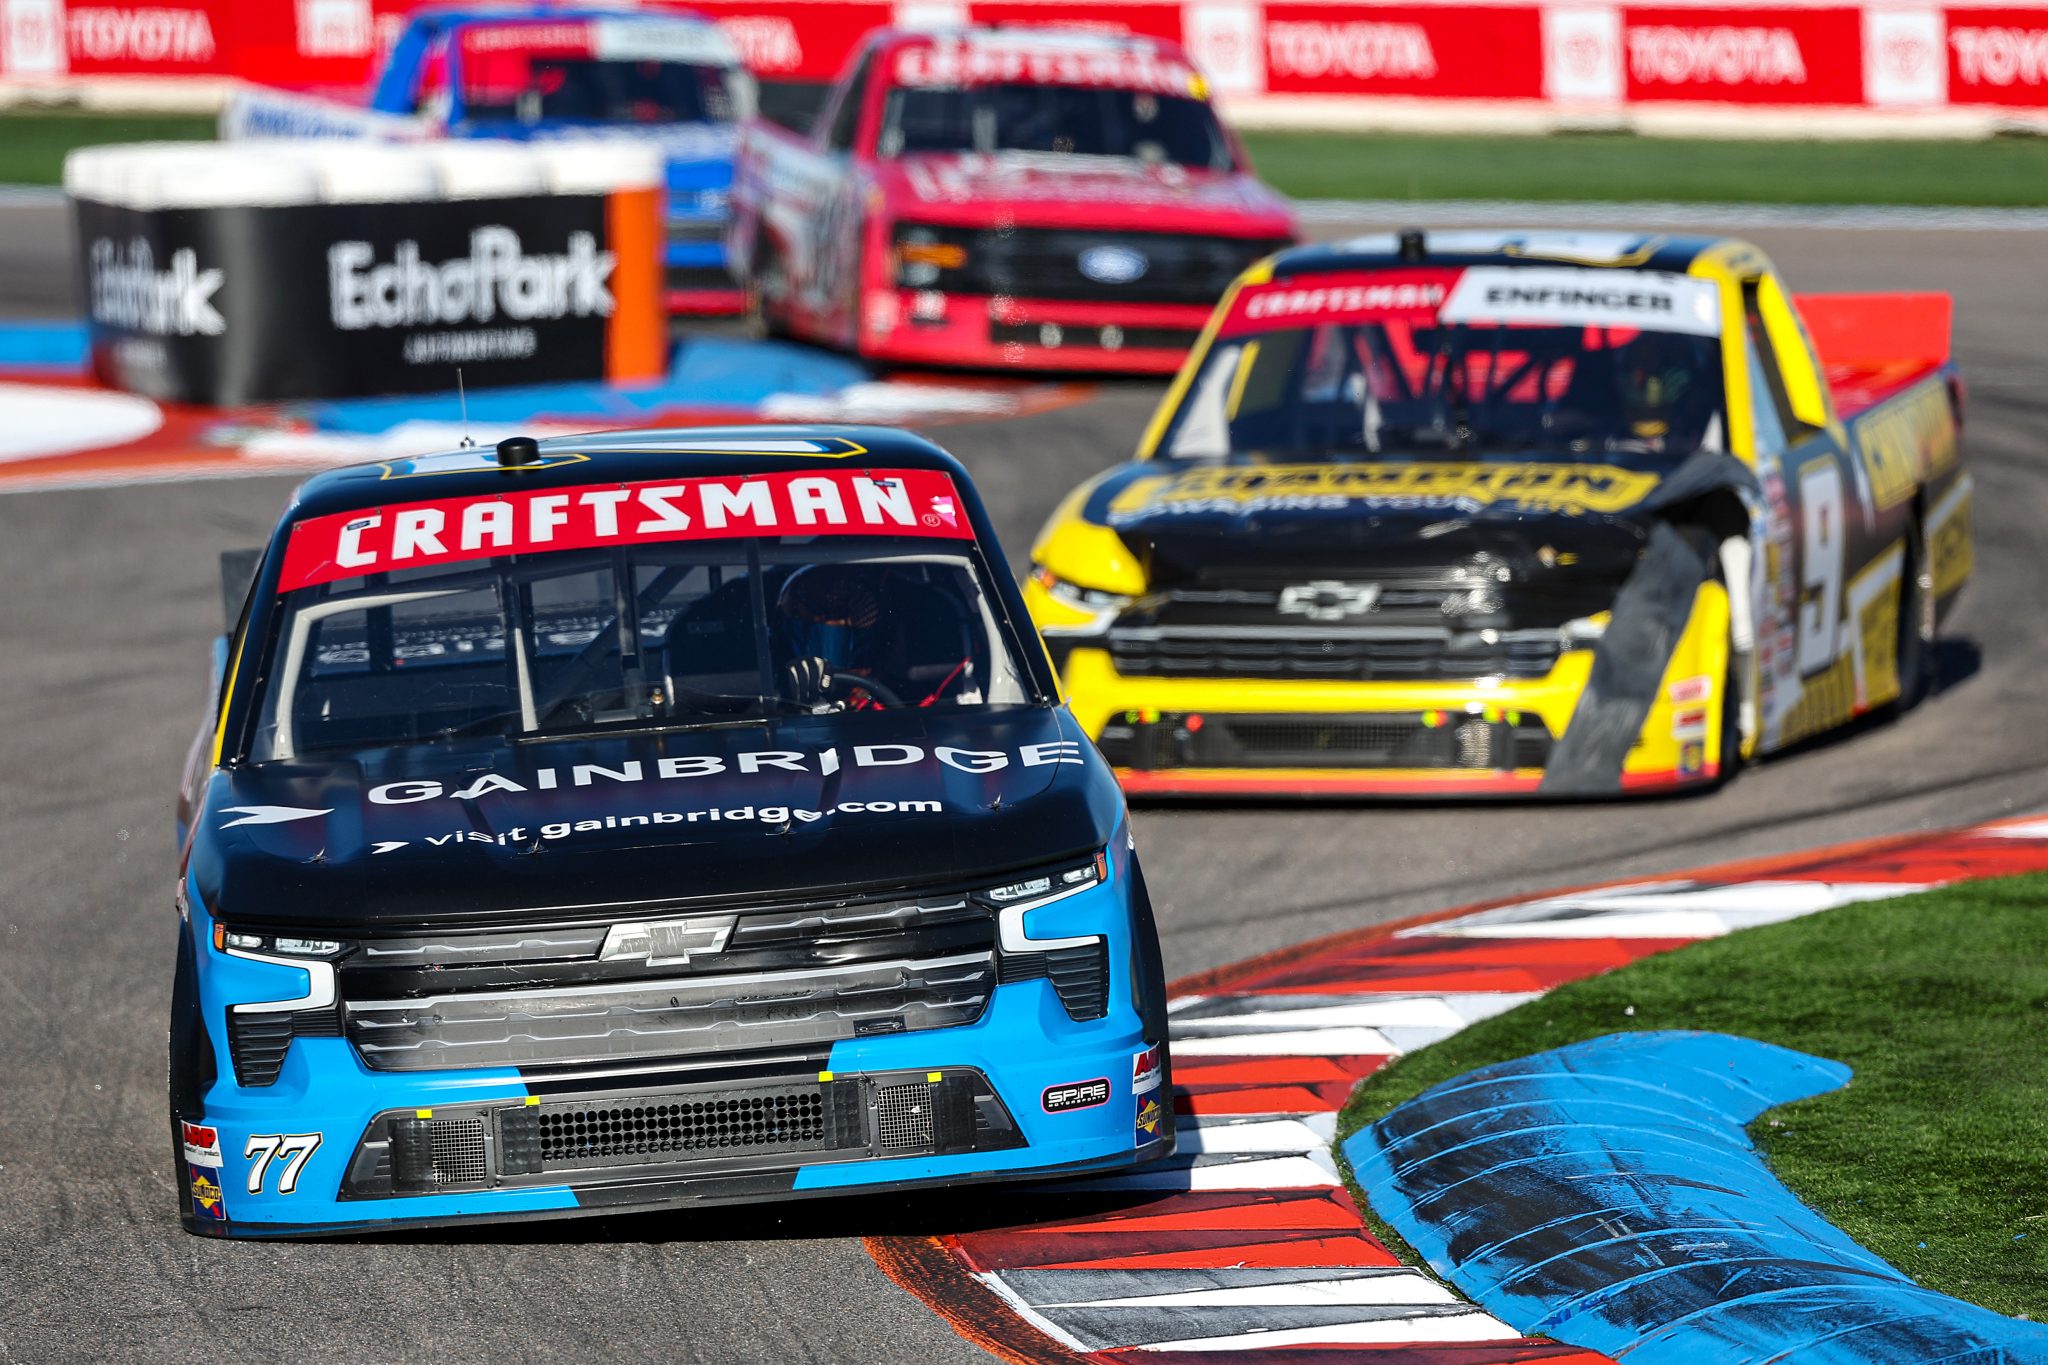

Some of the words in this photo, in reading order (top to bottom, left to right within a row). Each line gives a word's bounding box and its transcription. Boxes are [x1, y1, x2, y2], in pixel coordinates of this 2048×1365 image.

[67, 8, 214, 60] TOYOTA
[1267, 20, 1437, 79] TOYOTA
[1627, 25, 1807, 84] TOYOTA
[329, 224, 618, 330] EchoPark
[1244, 282, 1446, 320] CRAFTSMAN
[1486, 284, 1674, 312] ENFINGER
[335, 476, 917, 569] CRAFTSMAN
[1800, 460, 1847, 682] 9
[368, 741, 1084, 805] GAINBRIDGE
[424, 826, 528, 847] visit
[540, 798, 943, 841] gainbridge.com
[1048, 1083, 1106, 1104] SPIRE
[1048, 1094, 1106, 1108] MOTORSPORTS
[244, 1132, 323, 1195] 77
